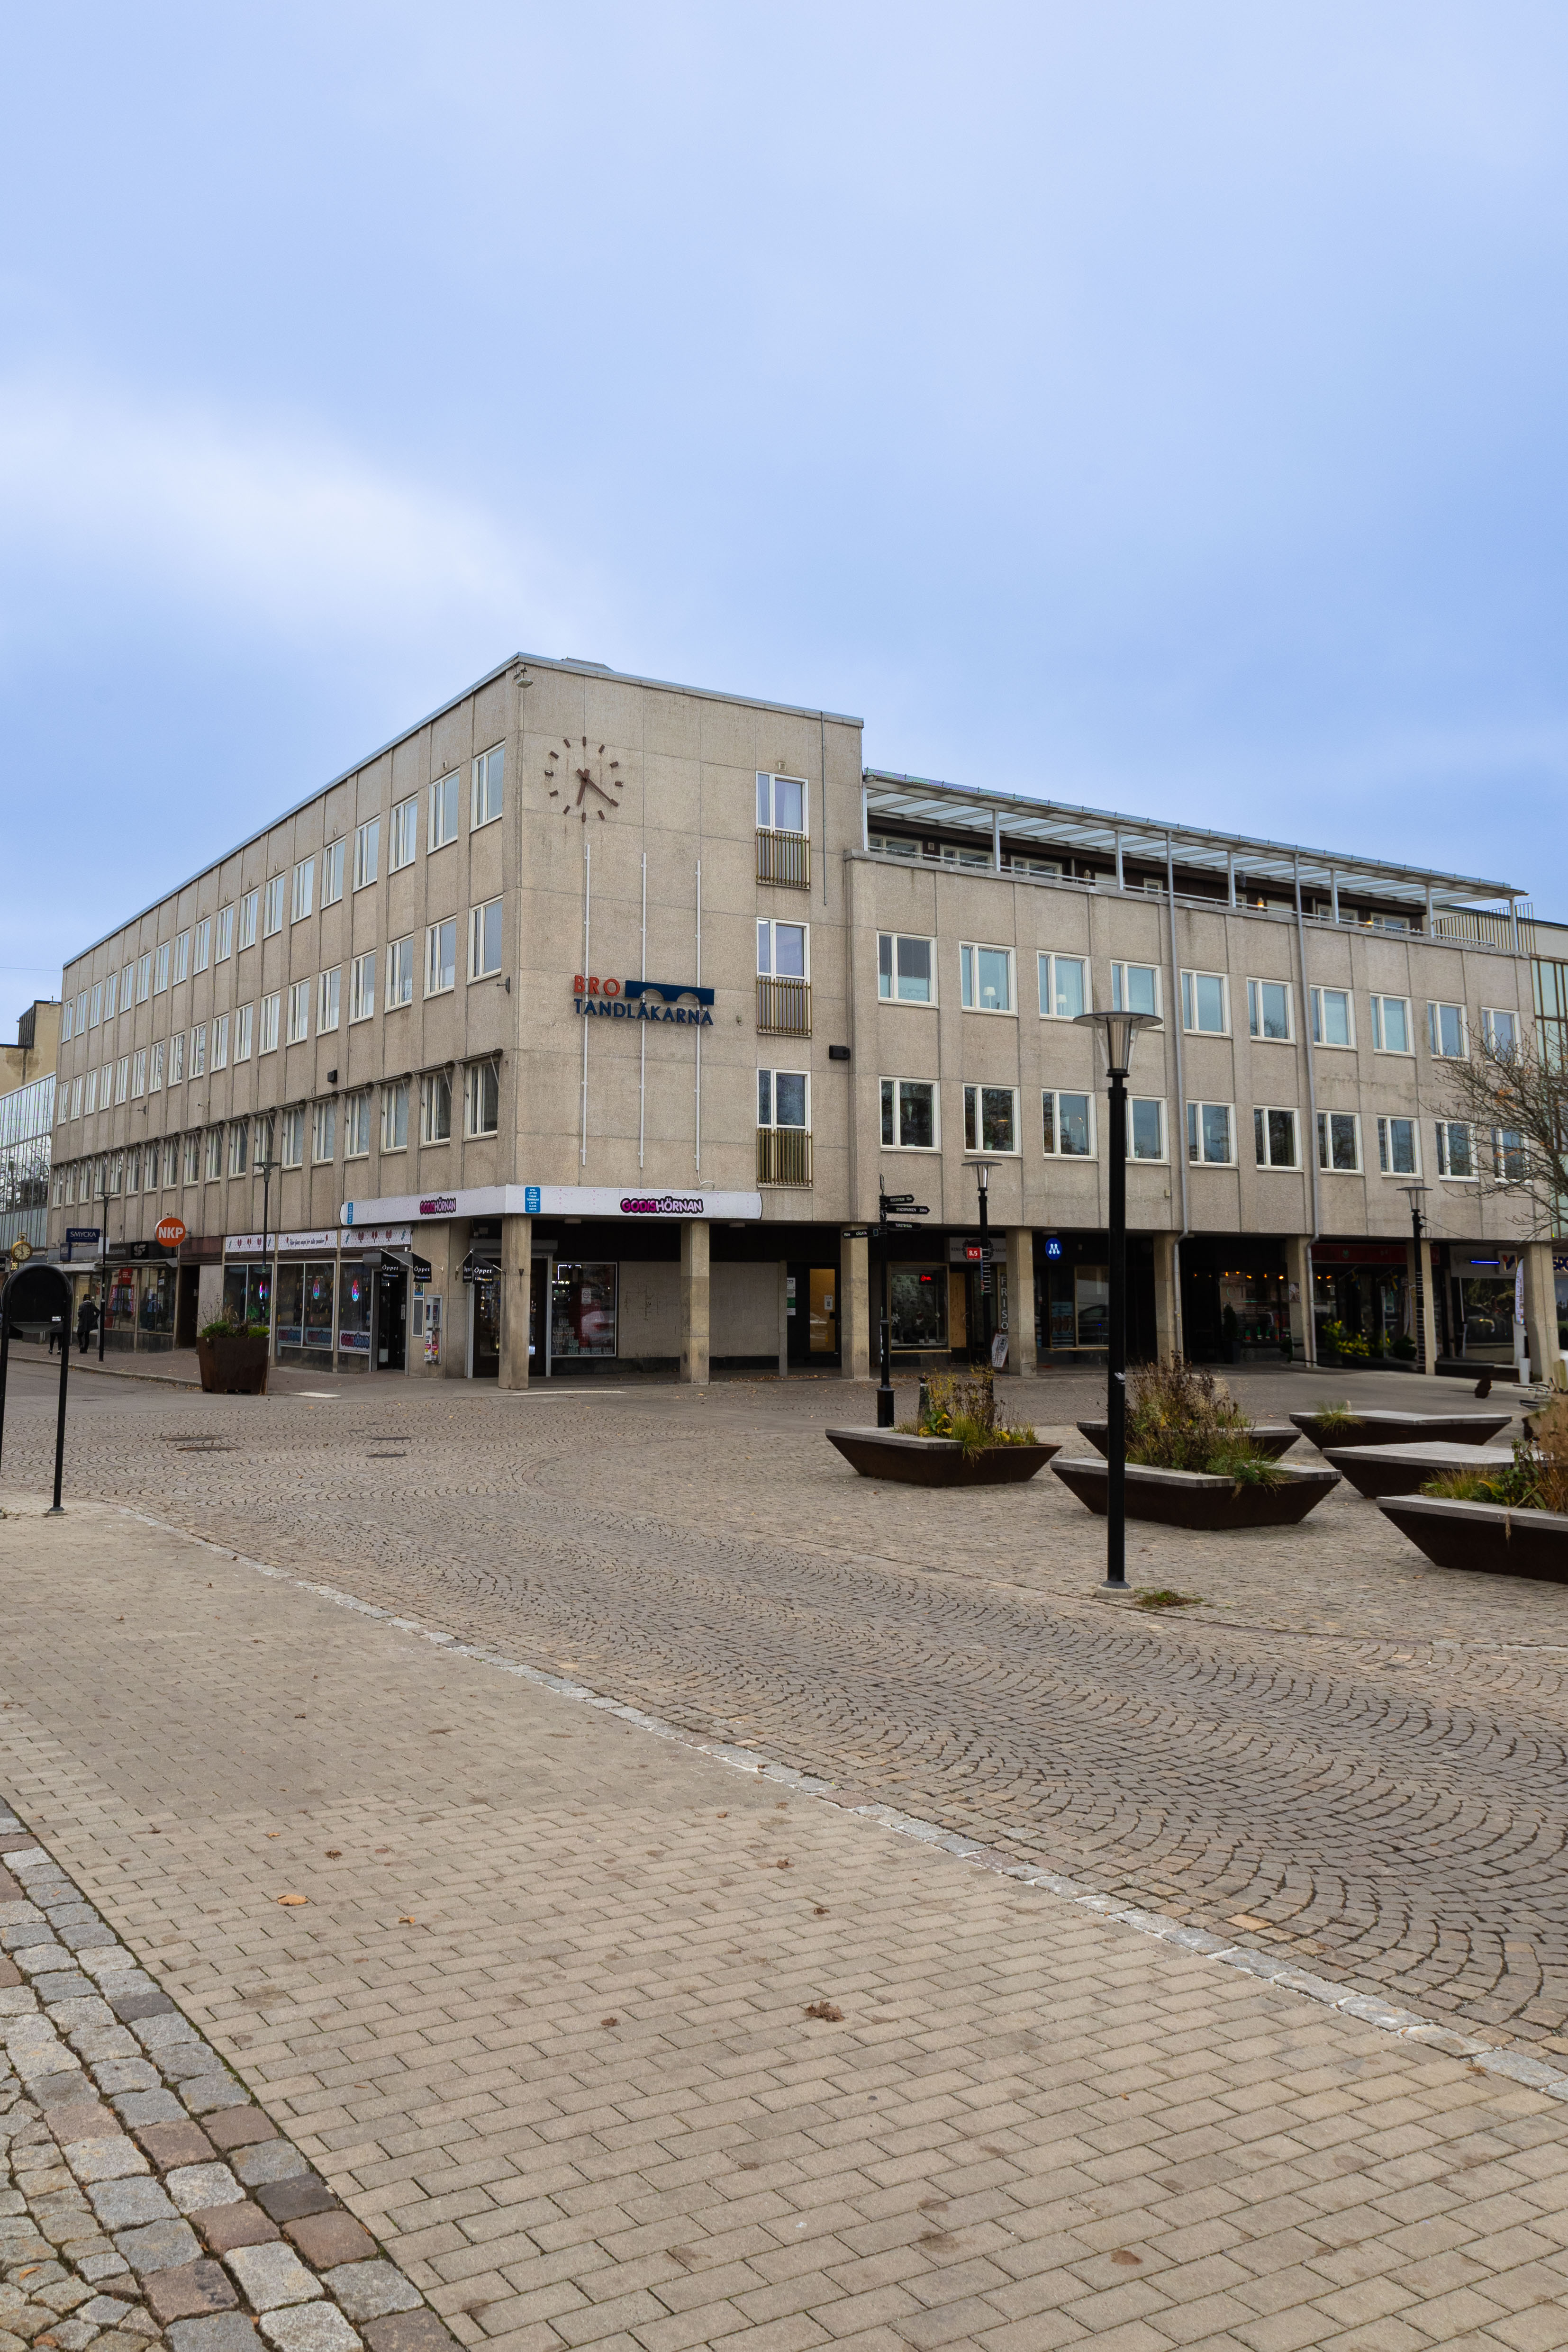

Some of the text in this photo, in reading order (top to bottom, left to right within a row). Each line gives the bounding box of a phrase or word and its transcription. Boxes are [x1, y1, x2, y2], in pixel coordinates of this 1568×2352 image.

[574, 975, 620, 996] BRO
[574, 998, 714, 1026] TANDLÄKARNA
[419, 1196, 456, 1215] GODISHÖRNAN
[620, 1196, 704, 1213] GODISHÖRNAN
[158, 1226, 184, 1239] NKP
